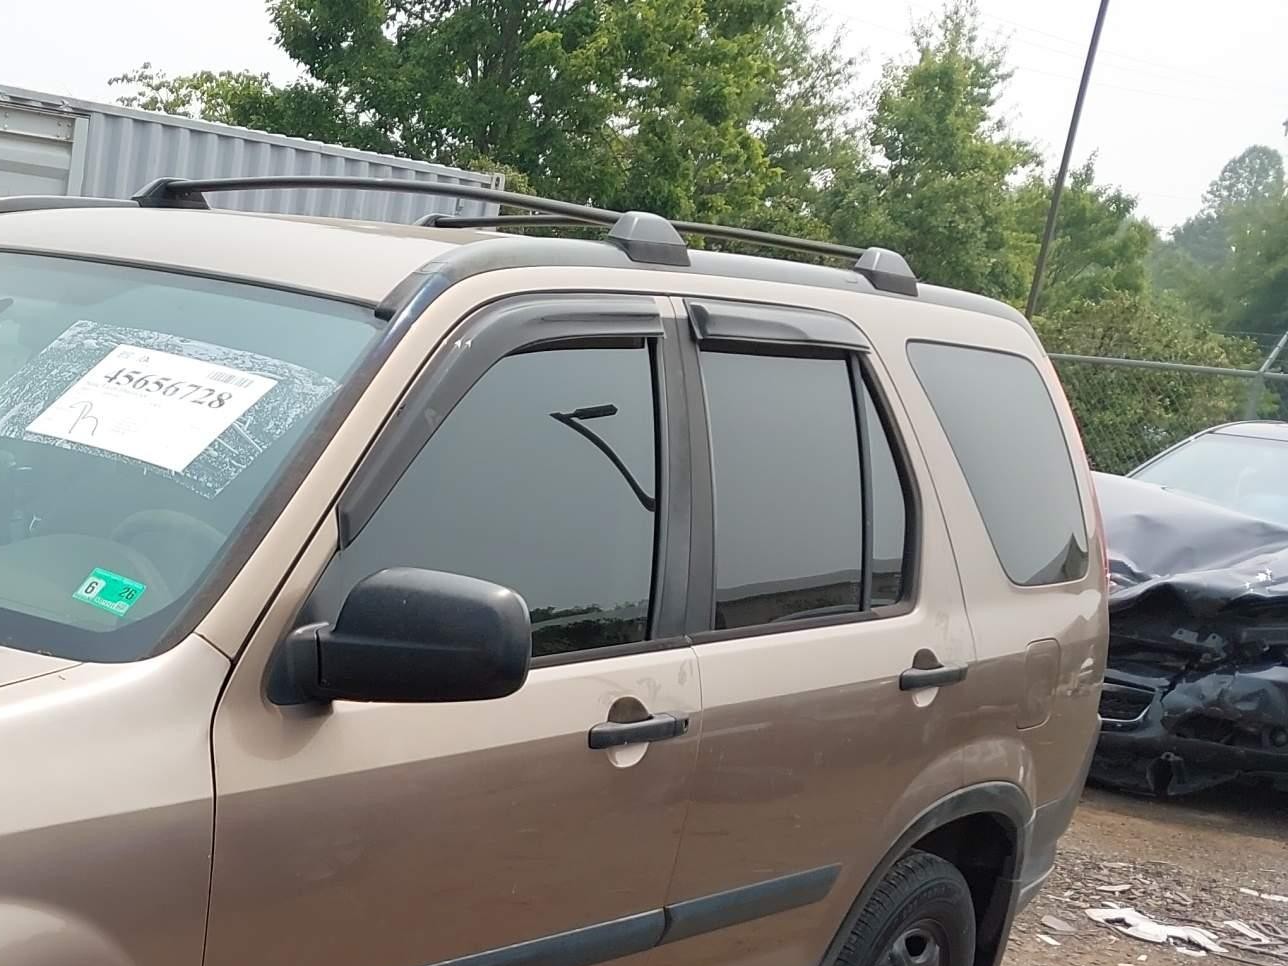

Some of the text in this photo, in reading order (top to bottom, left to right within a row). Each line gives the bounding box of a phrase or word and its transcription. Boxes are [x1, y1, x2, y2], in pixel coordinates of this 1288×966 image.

[104, 367, 233, 409] 45656728
[84, 581, 98, 594] 6
[119, 585, 137, 601] 26
